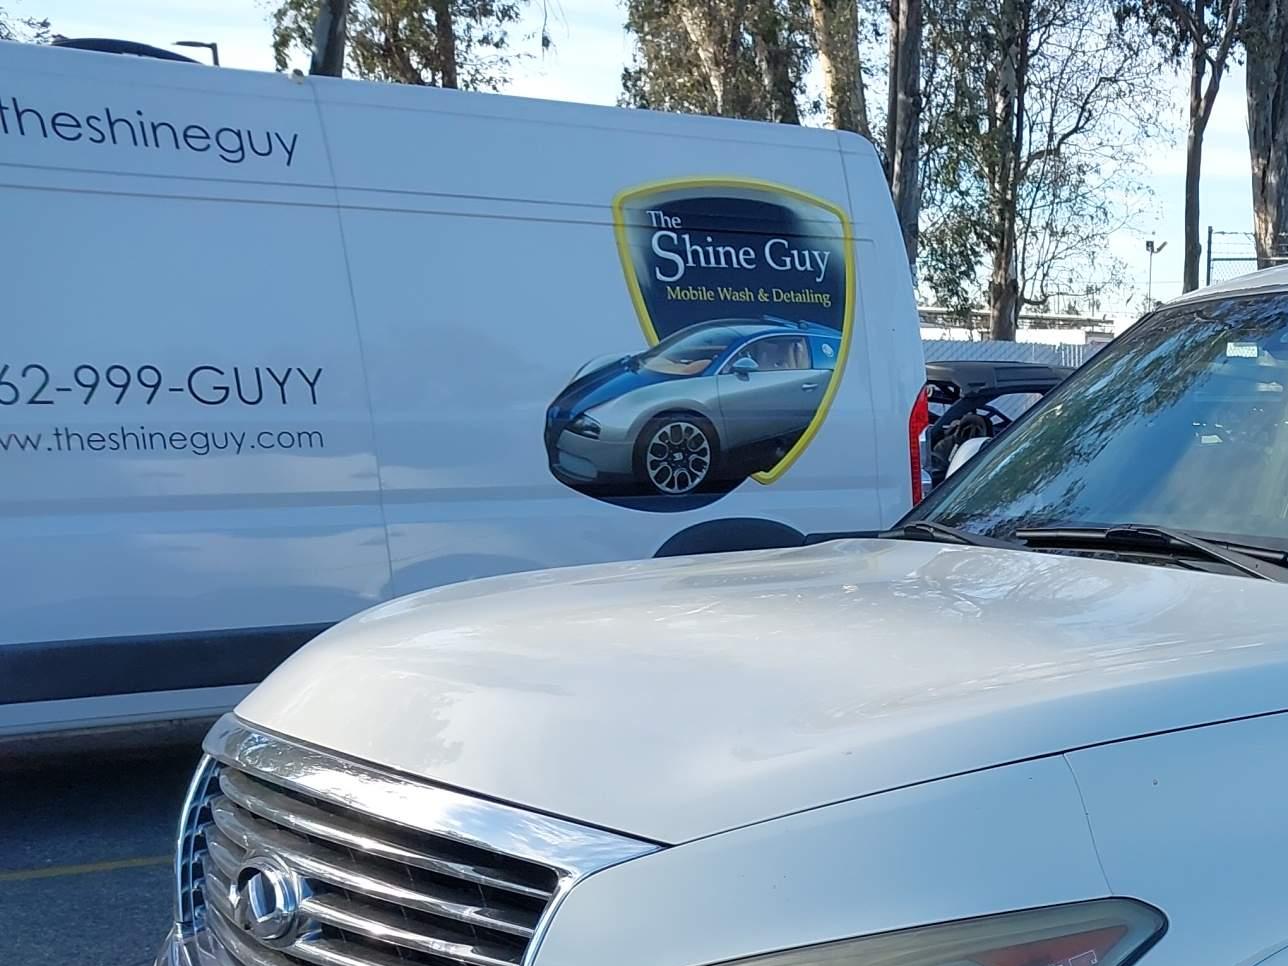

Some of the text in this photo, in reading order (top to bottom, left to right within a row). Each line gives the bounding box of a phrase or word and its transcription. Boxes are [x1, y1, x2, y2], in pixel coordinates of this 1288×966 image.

[0, 96, 299, 167] theshineguy
[647, 210, 682, 229] The
[651, 230, 831, 283] Shine Guy
[666, 286, 832, 308] Mobile Wash & Detailing
[0, 363, 323, 406] 62-999-GUYY
